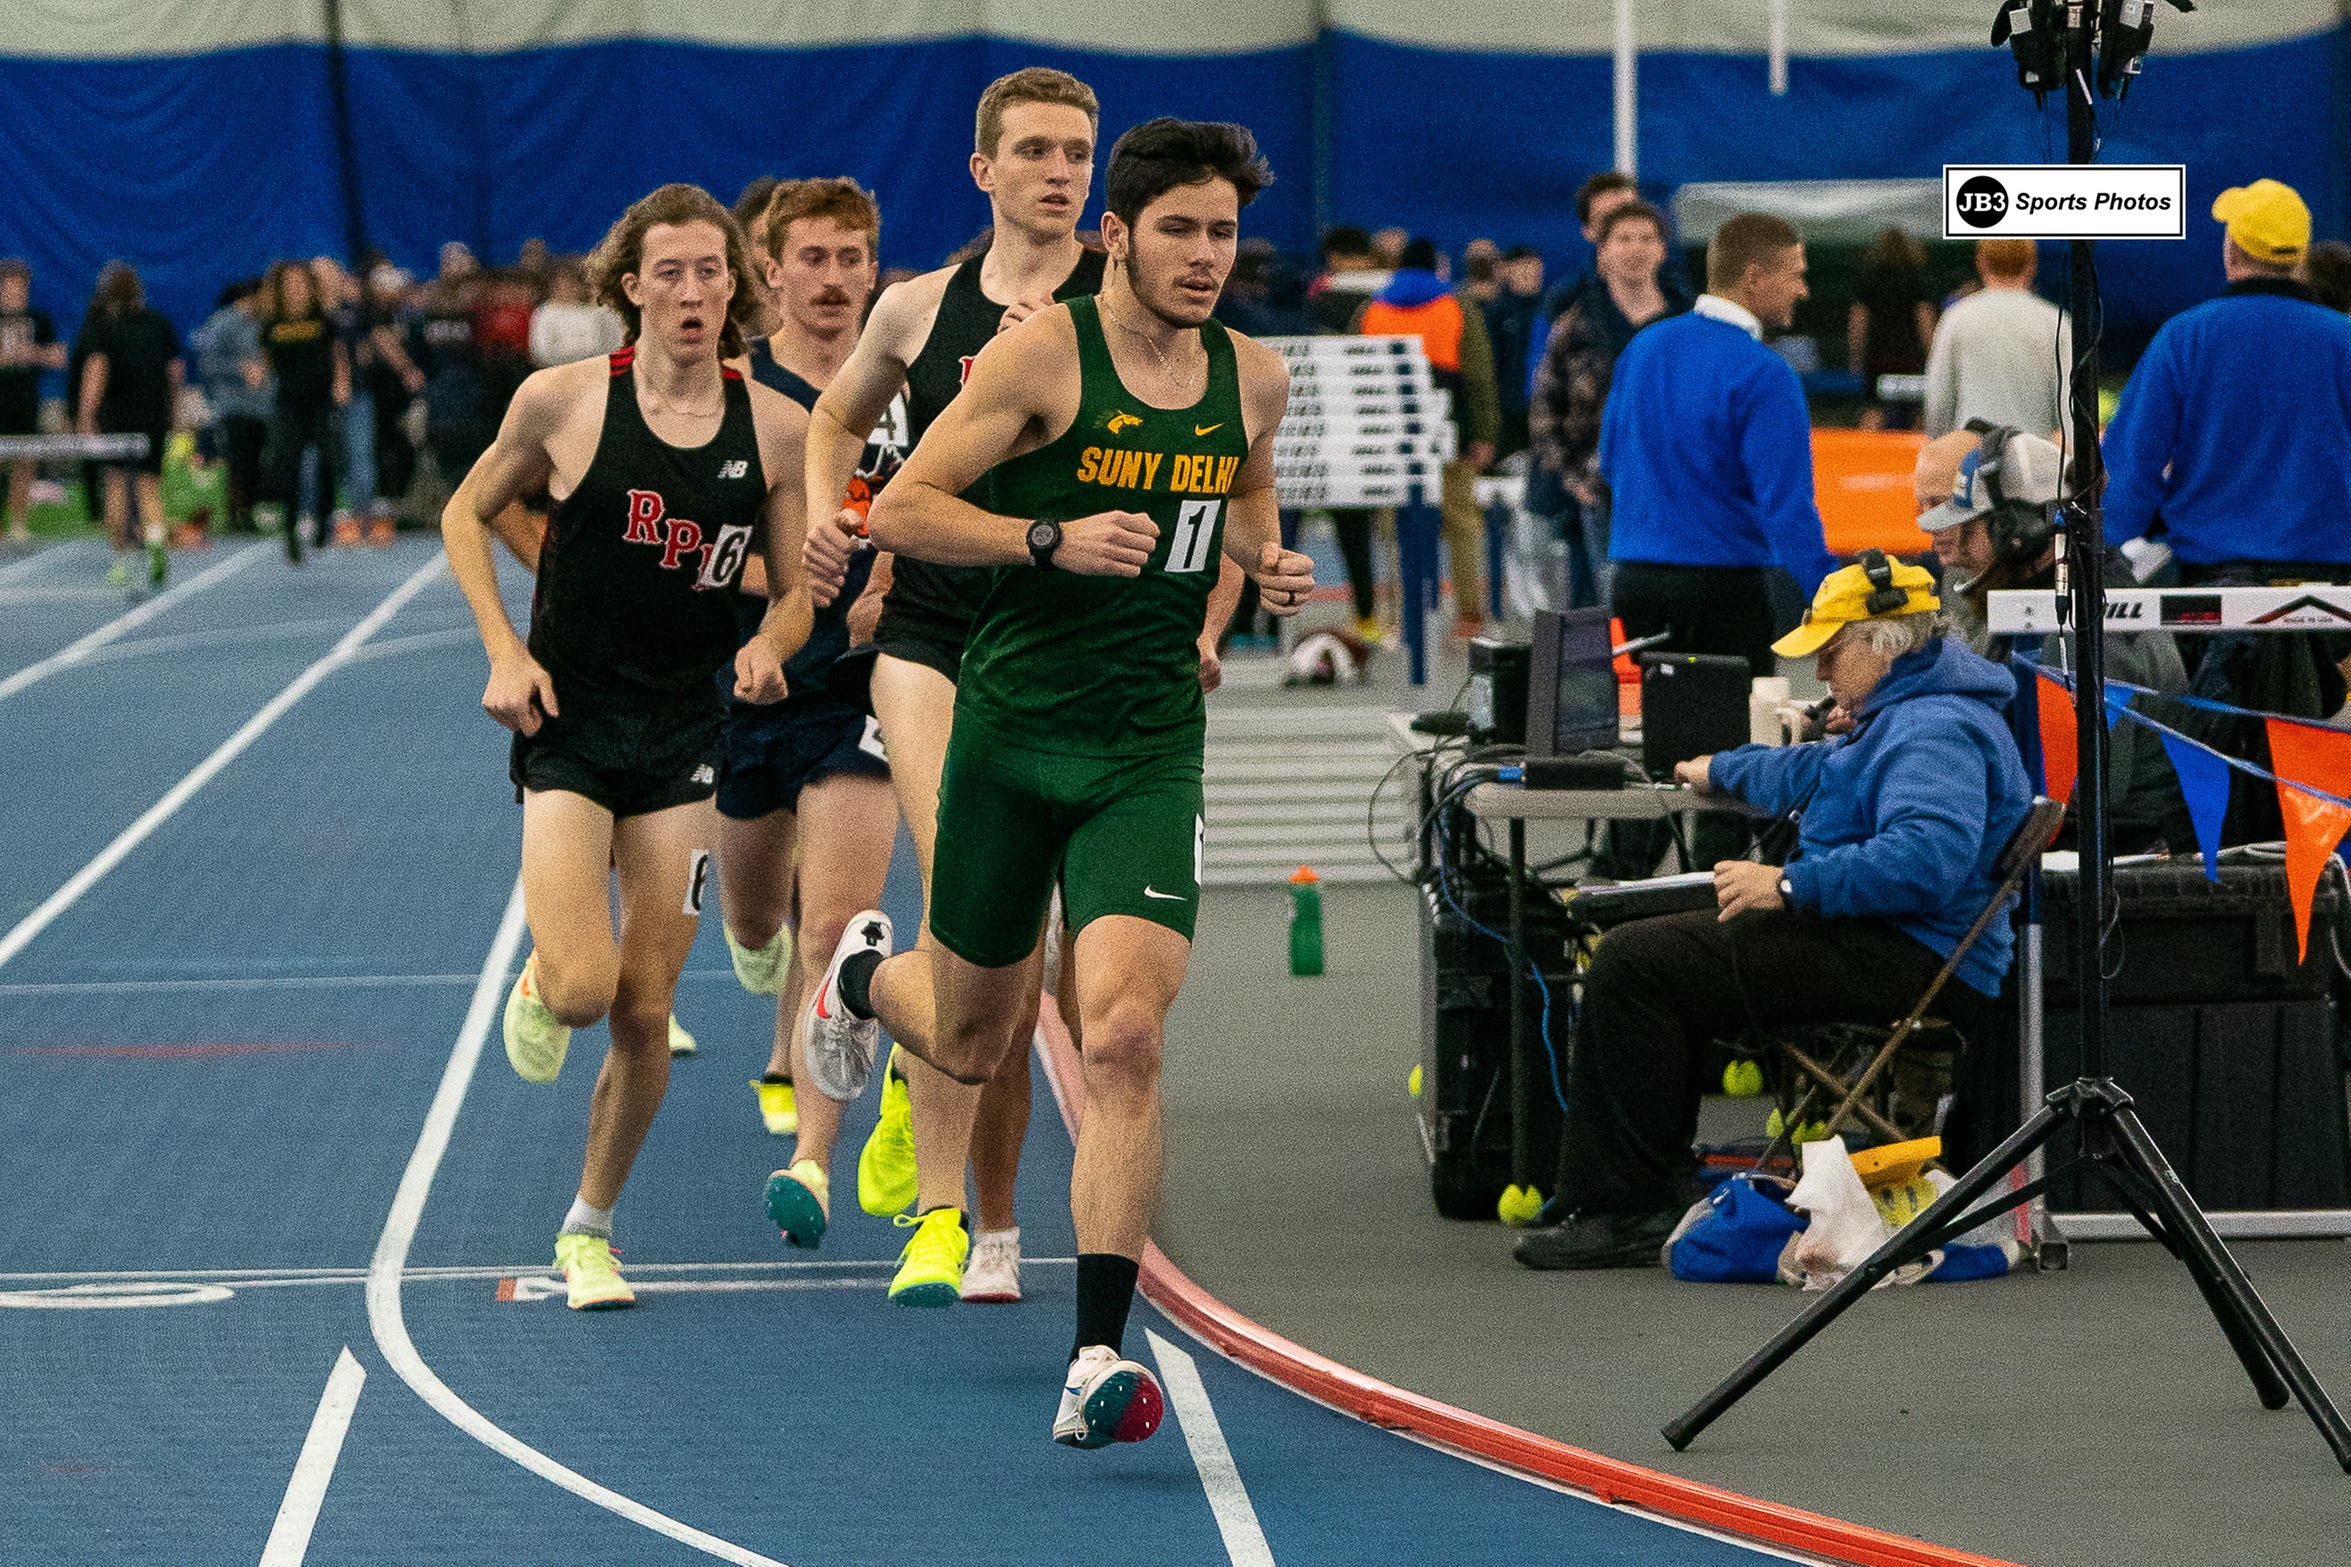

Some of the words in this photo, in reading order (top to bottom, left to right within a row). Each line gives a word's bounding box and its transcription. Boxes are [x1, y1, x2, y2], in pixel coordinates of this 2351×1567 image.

[1076, 446, 1163, 490] SUNY
[712, 530, 745, 582] 6
[1183, 505, 1207, 570] 1
[2101, 602, 2142, 618] ILL
